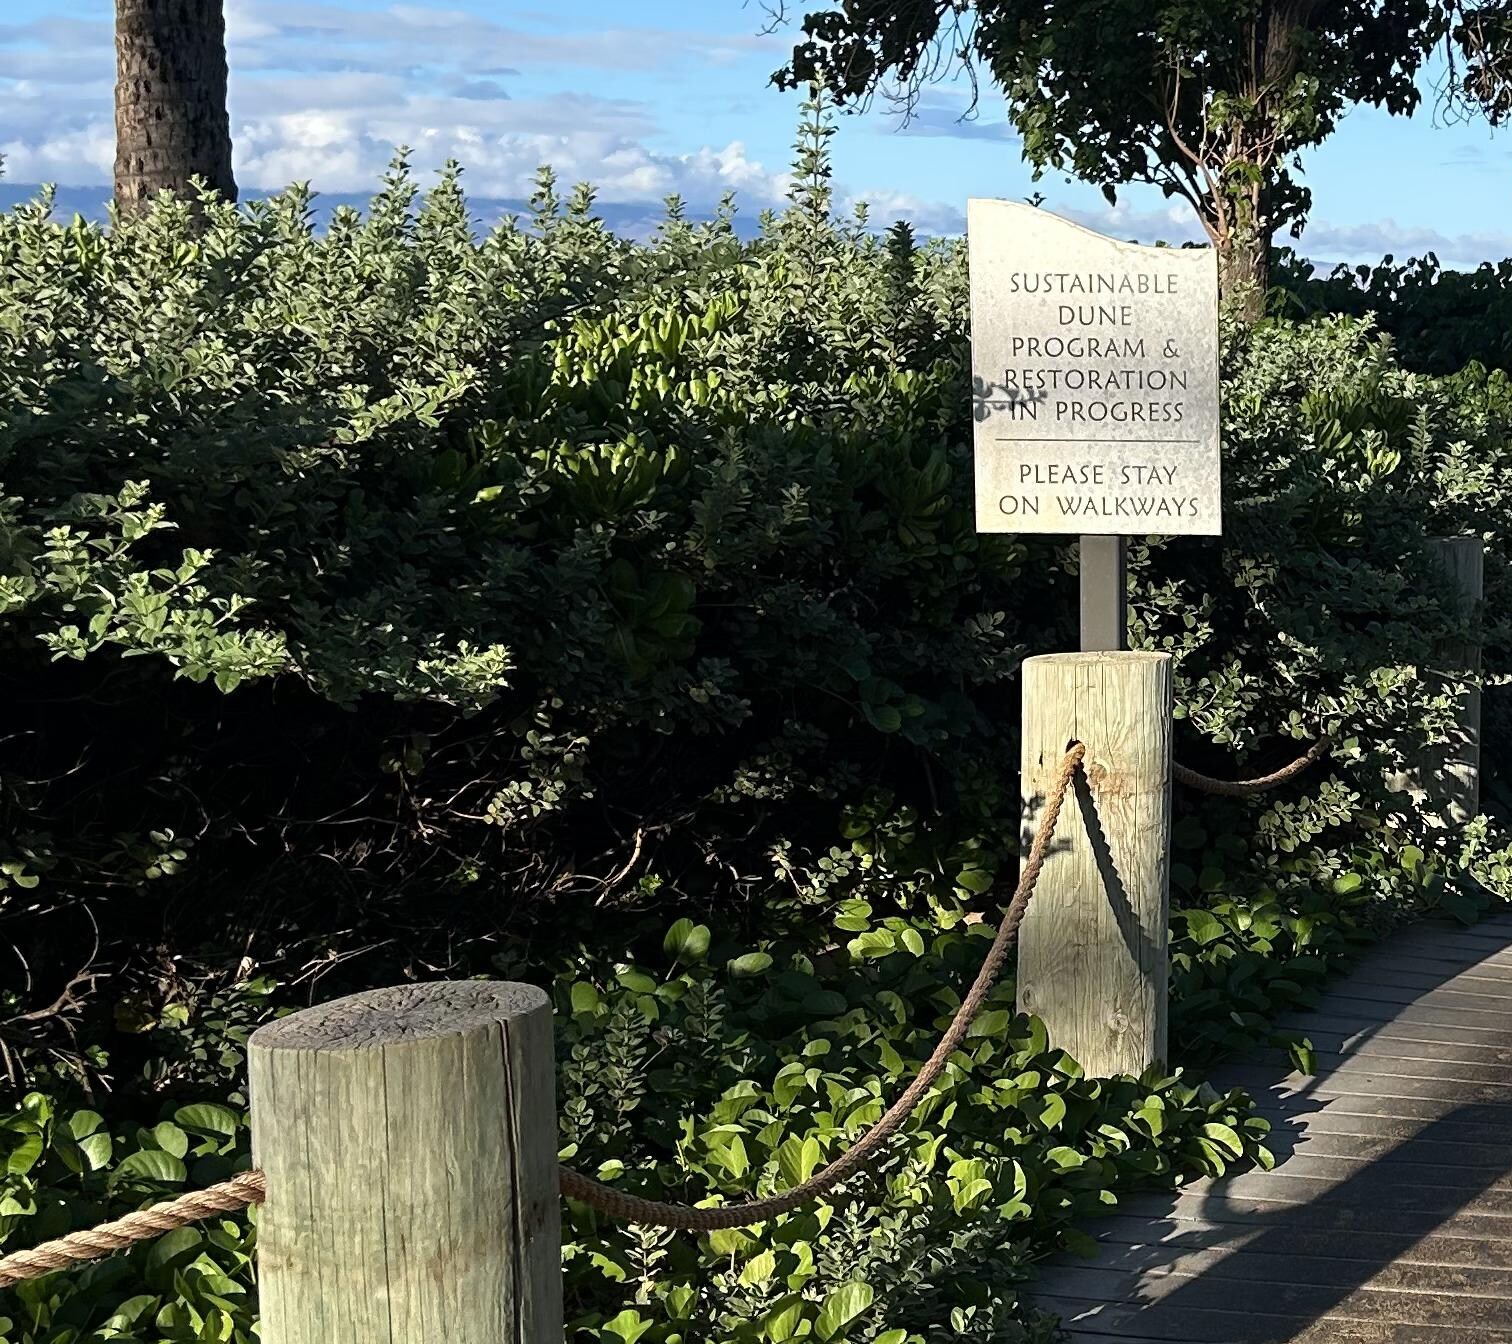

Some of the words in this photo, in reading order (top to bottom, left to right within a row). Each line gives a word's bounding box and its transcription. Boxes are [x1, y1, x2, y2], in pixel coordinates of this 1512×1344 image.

[1010, 272, 1179, 294] SUSTAINABLE
[1058, 305, 1132, 326] DUNE
[1011, 337, 1146, 358] PROGRAM
[1163, 338, 1181, 358] &
[1004, 369, 1188, 390] RESTORATION
[1010, 401, 1037, 422] IN
[1056, 401, 1184, 422] PROGRESS
[1019, 464, 1104, 484] PLEASE
[1121, 465, 1178, 485] STAY
[999, 495, 1039, 515] ON
[1056, 496, 1199, 517] WALKWAYS
